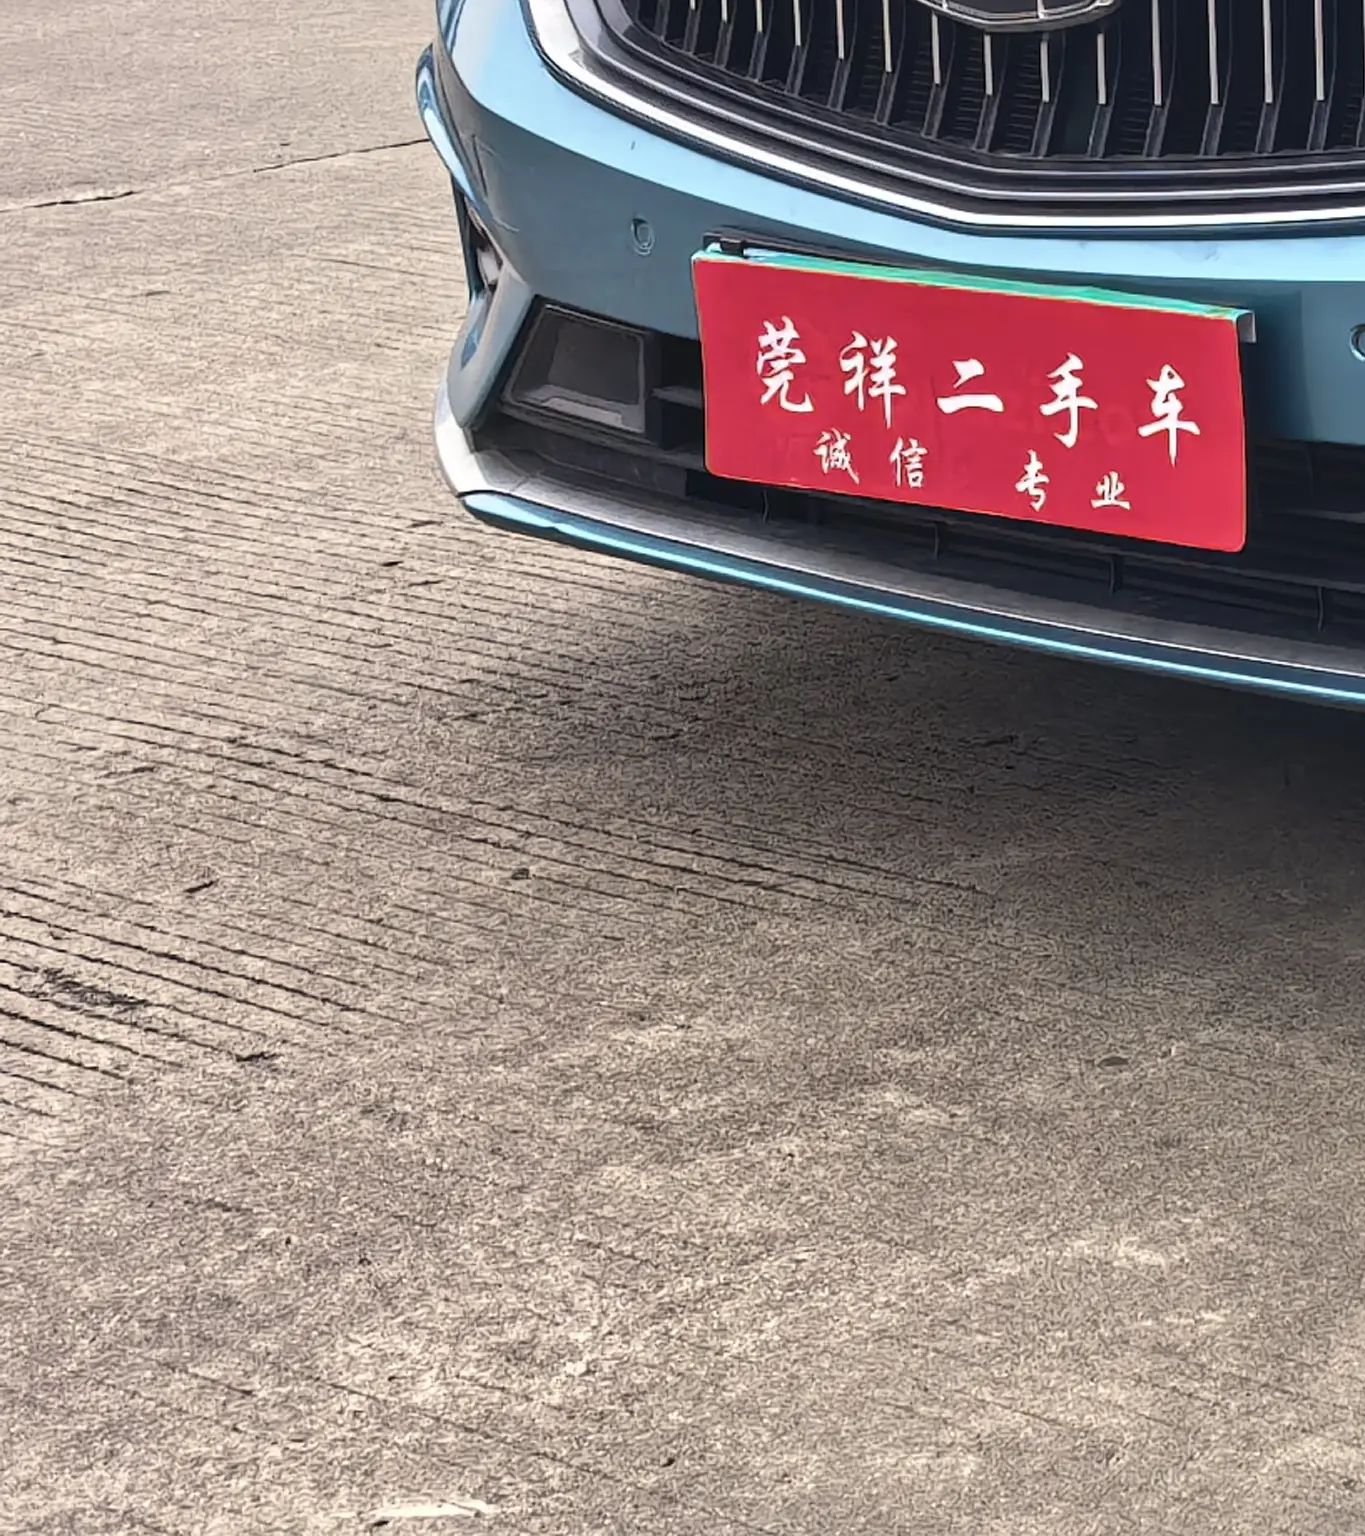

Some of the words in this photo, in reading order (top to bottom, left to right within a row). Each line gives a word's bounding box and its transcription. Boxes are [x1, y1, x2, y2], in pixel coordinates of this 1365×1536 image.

[755, 316, 1202, 467] 莞祥二手车
[813, 426, 929, 489] 诚信
[1015, 450, 1131, 512] 专业
